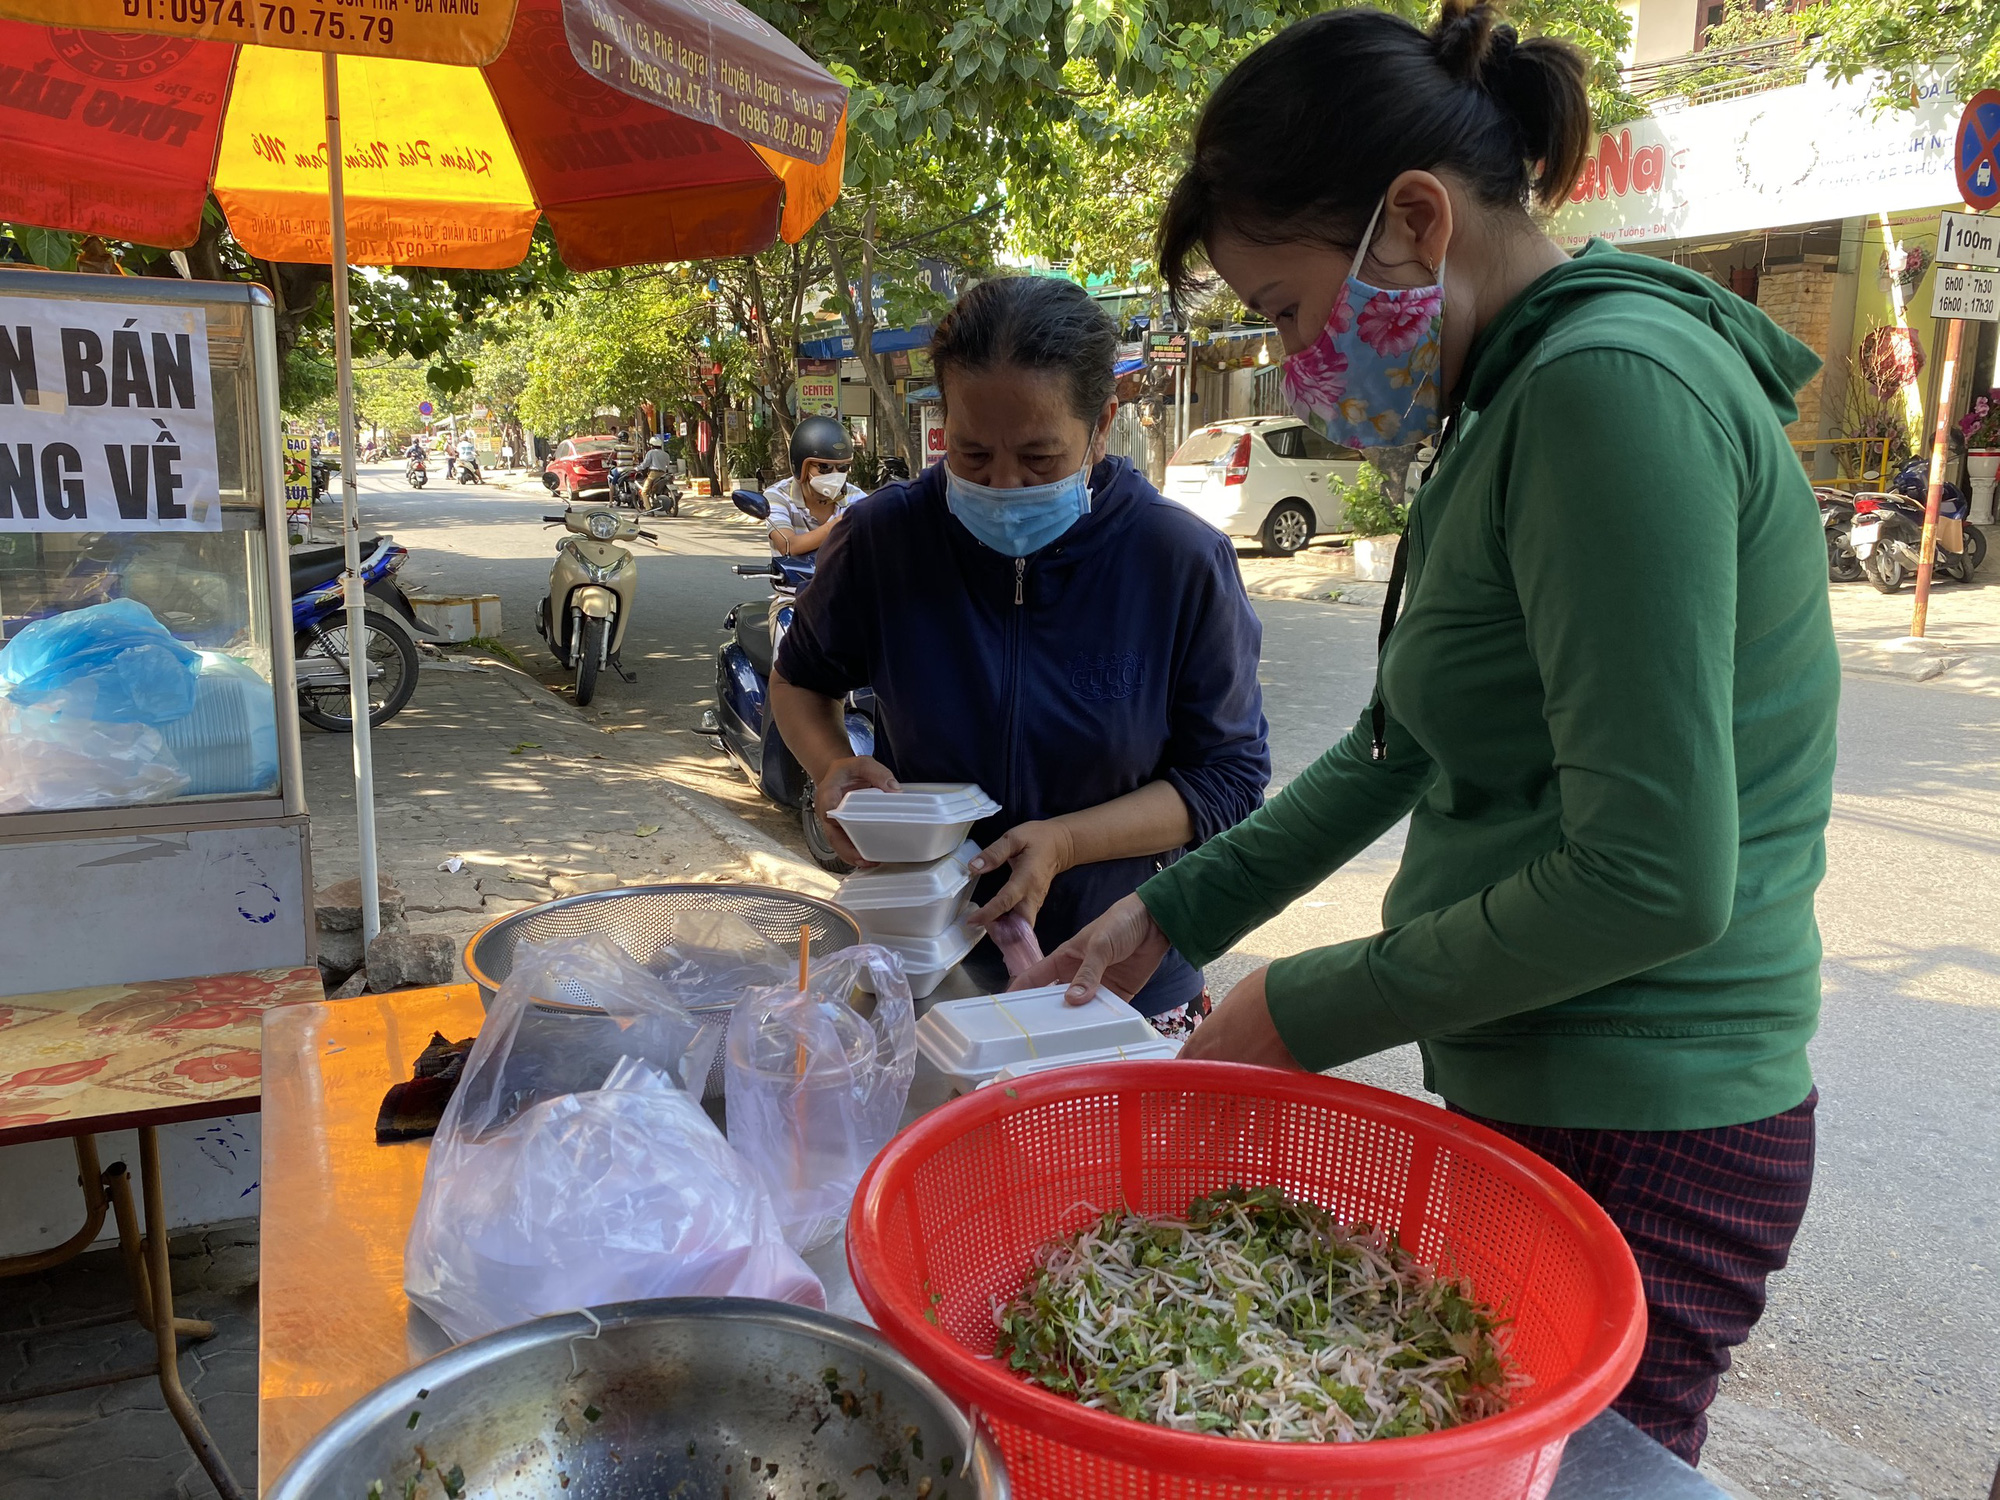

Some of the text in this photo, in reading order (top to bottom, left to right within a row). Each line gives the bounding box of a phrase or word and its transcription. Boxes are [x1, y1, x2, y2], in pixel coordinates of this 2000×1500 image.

[589, 1, 619, 43] Công
[618, 15, 633, 51] Ty
[636, 22, 650, 53] Cà
[654, 30, 673, 64] Phê
[721, 58, 752, 96] Huyện
[792, 88, 809, 116] Gia
[811, 95, 826, 123] Lai
[591, 40, 823, 154] ĐT 0593.84.47.51 0986.80.80.90
[1601, 230, 1616, 241] Huy
[1653, 224, 1667, 234] ĐN
[1956, 229, 1993, 251] 100m
[1945, 277, 1992, 294] 6h00 7h30
[1939, 297, 1994, 313] 16h00 17h30
[61, 318, 196, 410] BÁN
[802, 385, 834, 396] CENTER
[287, 439, 307, 453] GẠO
[0, 418, 188, 521] NG VỀ
[286, 484, 309, 500] LÚA
